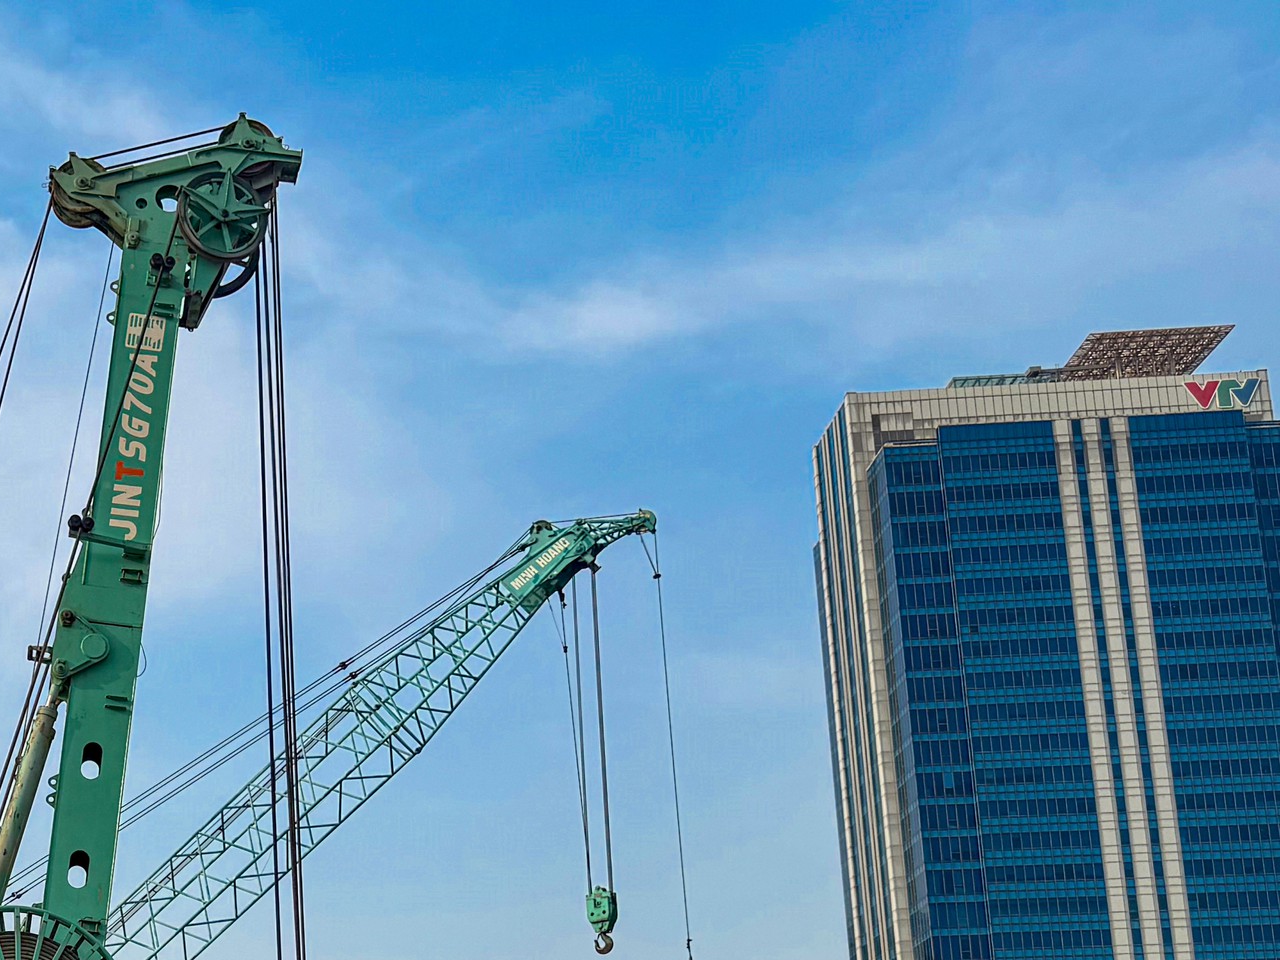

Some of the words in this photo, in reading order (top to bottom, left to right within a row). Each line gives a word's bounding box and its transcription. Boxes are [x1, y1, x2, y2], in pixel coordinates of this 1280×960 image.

[119, 352, 158, 462] SG70A
[1183, 379, 1260, 409] VTV
[109, 461, 144, 541] JINT
[510, 565, 539, 591] MINH
[535, 537, 571, 569] HOANG
